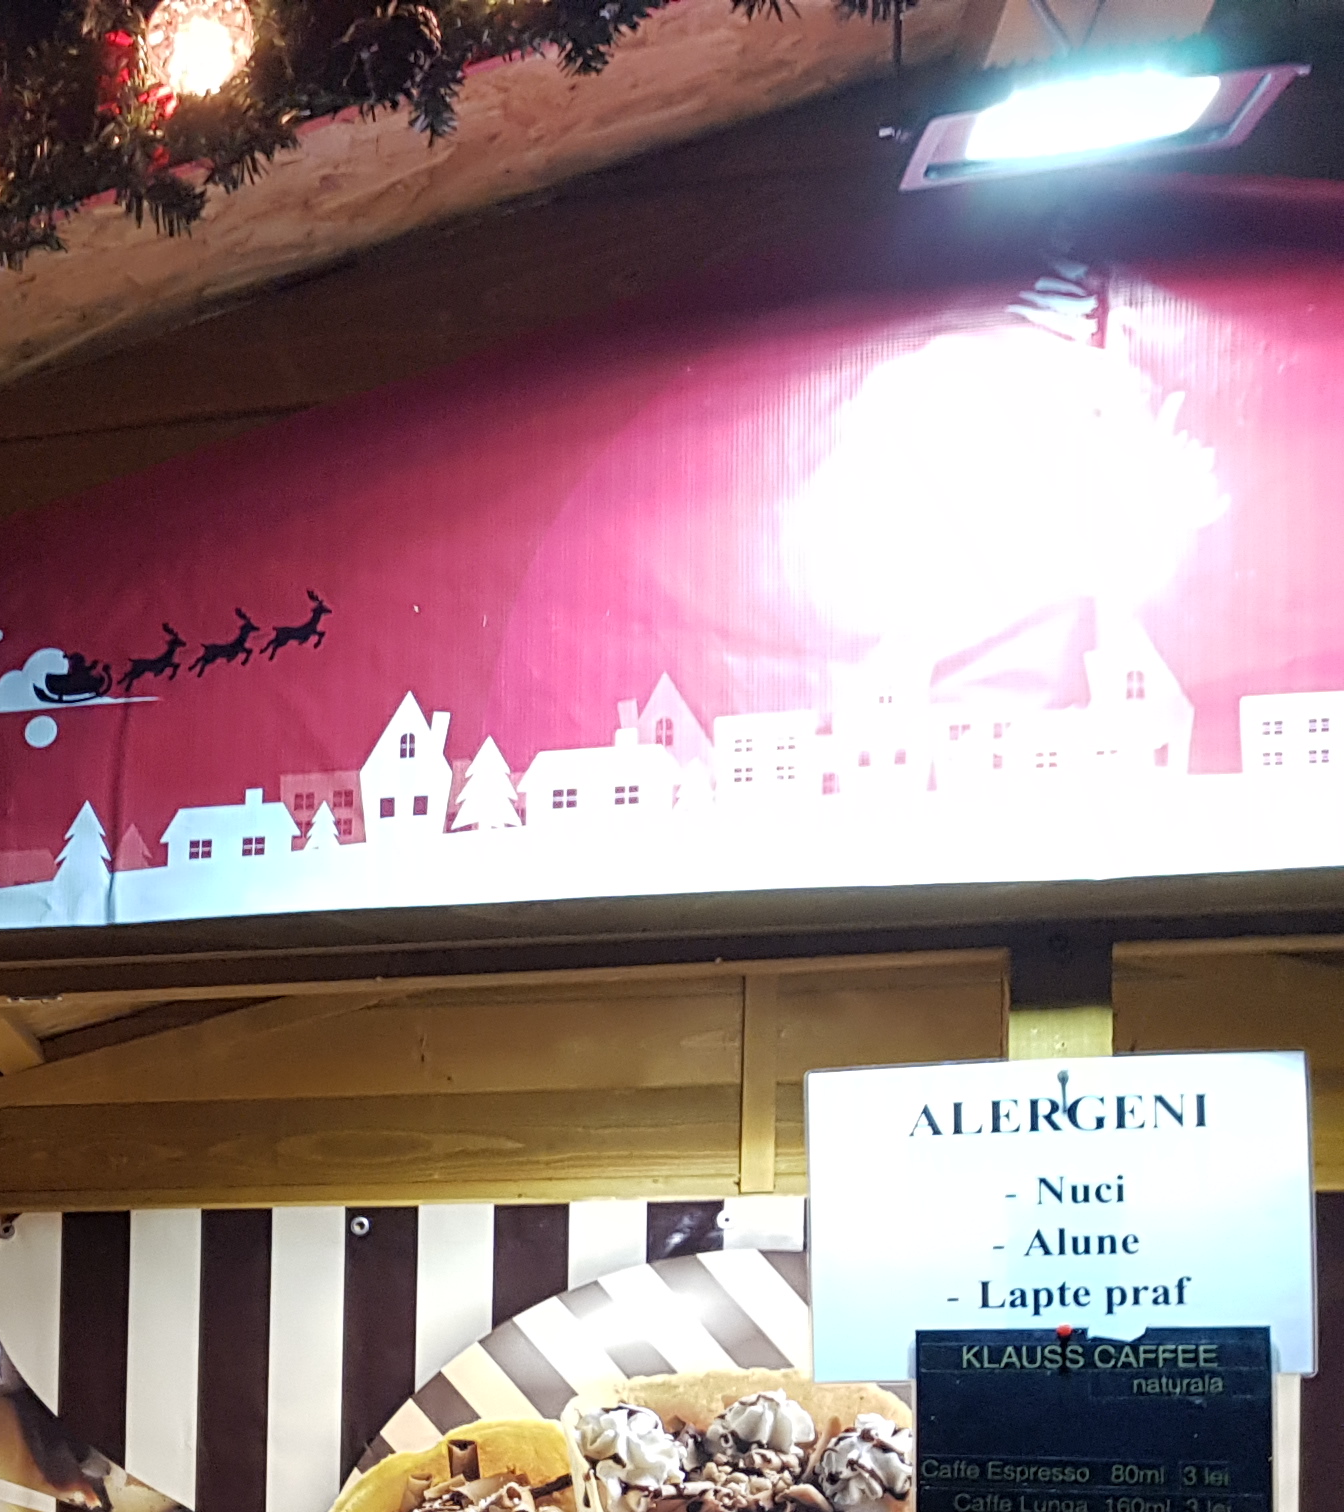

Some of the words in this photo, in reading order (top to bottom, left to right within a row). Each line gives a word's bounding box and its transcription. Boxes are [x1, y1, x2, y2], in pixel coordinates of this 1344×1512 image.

[909, 1093, 1207, 1137] ALERGENI
[1036, 1175, 1125, 1206] Nuci
[1023, 1227, 1140, 1257] Alune
[978, 1280, 1091, 1317] Lapte
[1105, 1276, 1192, 1316] praf
[961, 1345, 1086, 1369] KLAUSS
[1093, 1344, 1218, 1368] CAFFEE
[1132, 1374, 1224, 1396] naturala
[922, 1459, 981, 1480] Caffe
[987, 1461, 1090, 1484] Espresso
[1111, 1464, 1165, 1485] 80ml
[1183, 1467, 1200, 1486] 3
[1204, 1467, 1230, 1486] lei
